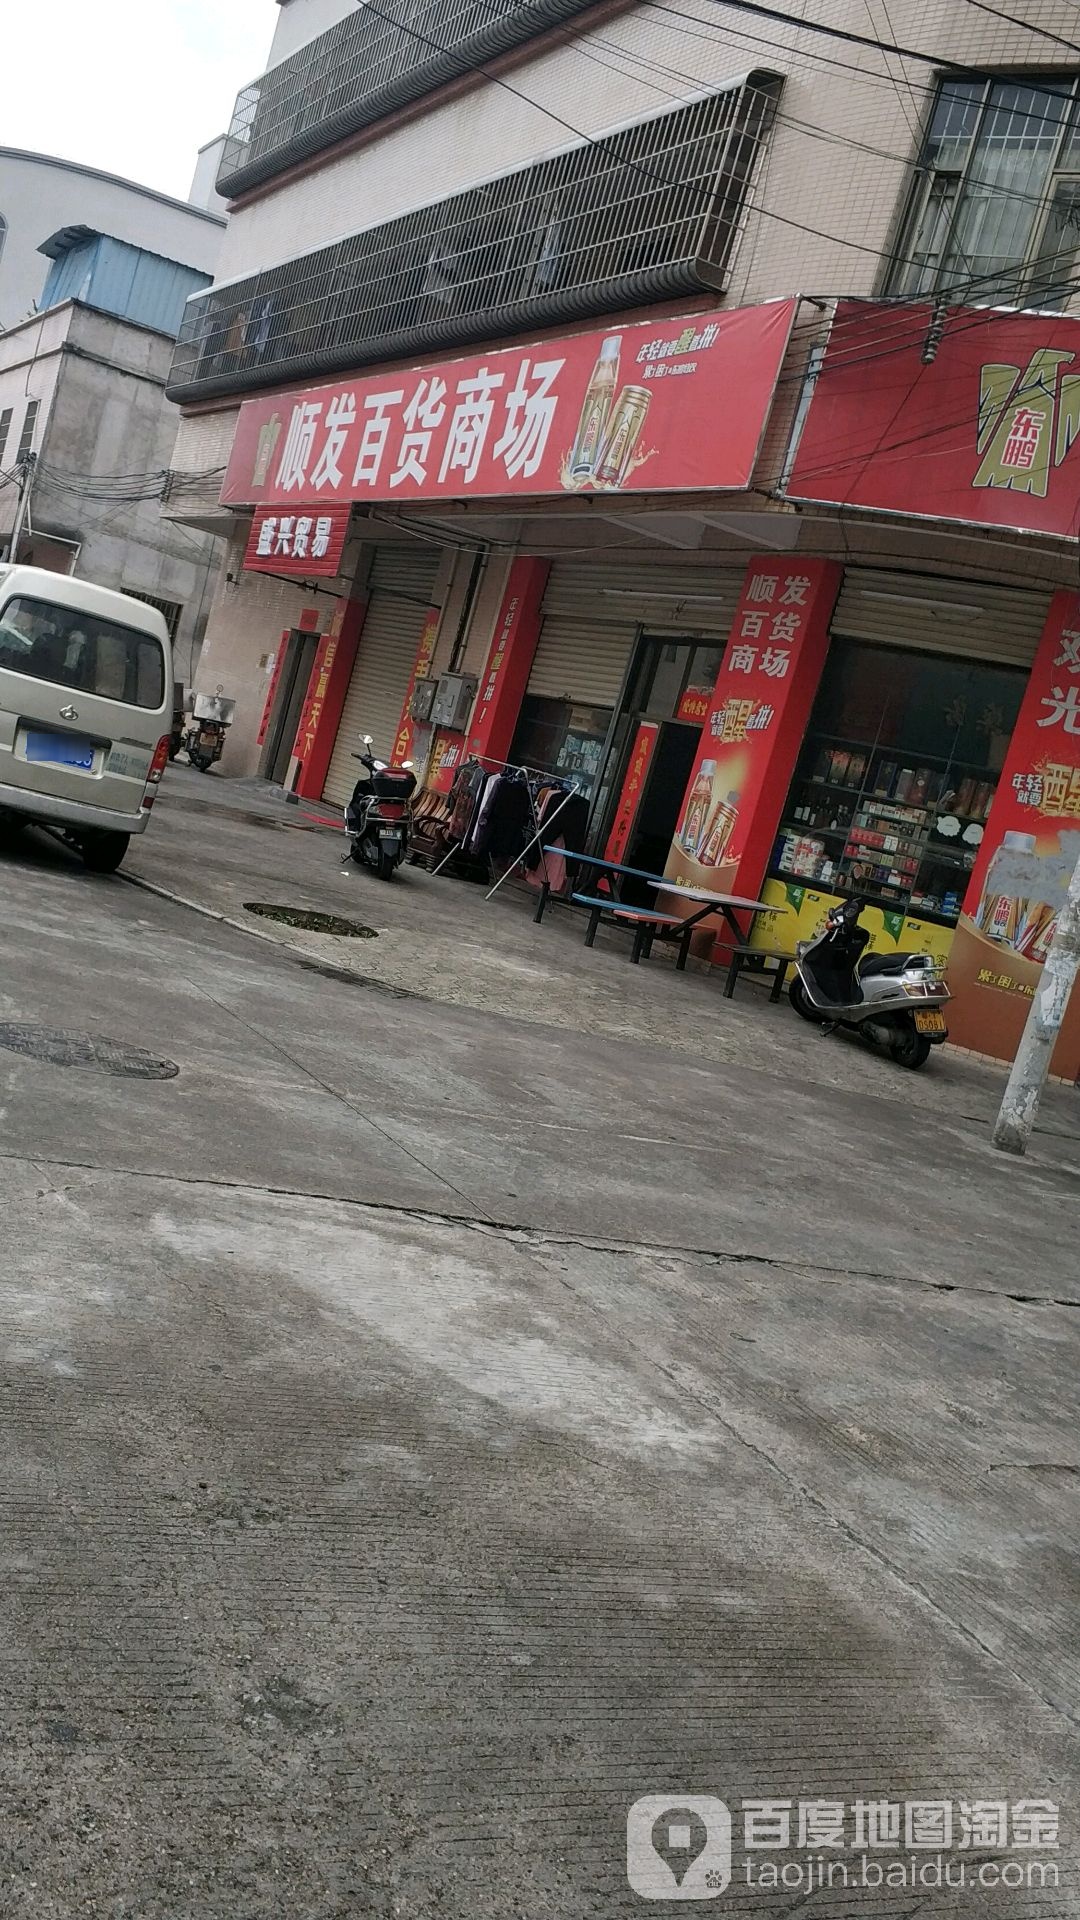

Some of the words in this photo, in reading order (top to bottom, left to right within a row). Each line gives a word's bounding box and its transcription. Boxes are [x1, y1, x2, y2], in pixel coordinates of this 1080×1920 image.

[274, 358, 567, 492] 顺发百货商场
[1001, 407, 1046, 469] 东鹏
[256, 516, 332, 558] 盛兴贸易
[746, 574, 811, 606] 顺发
[740, 610, 801, 642] 百货
[728, 644, 792, 678] 商场
[303, 612, 345, 757] 信赢天下
[1011, 773, 1044, 793] 年轻
